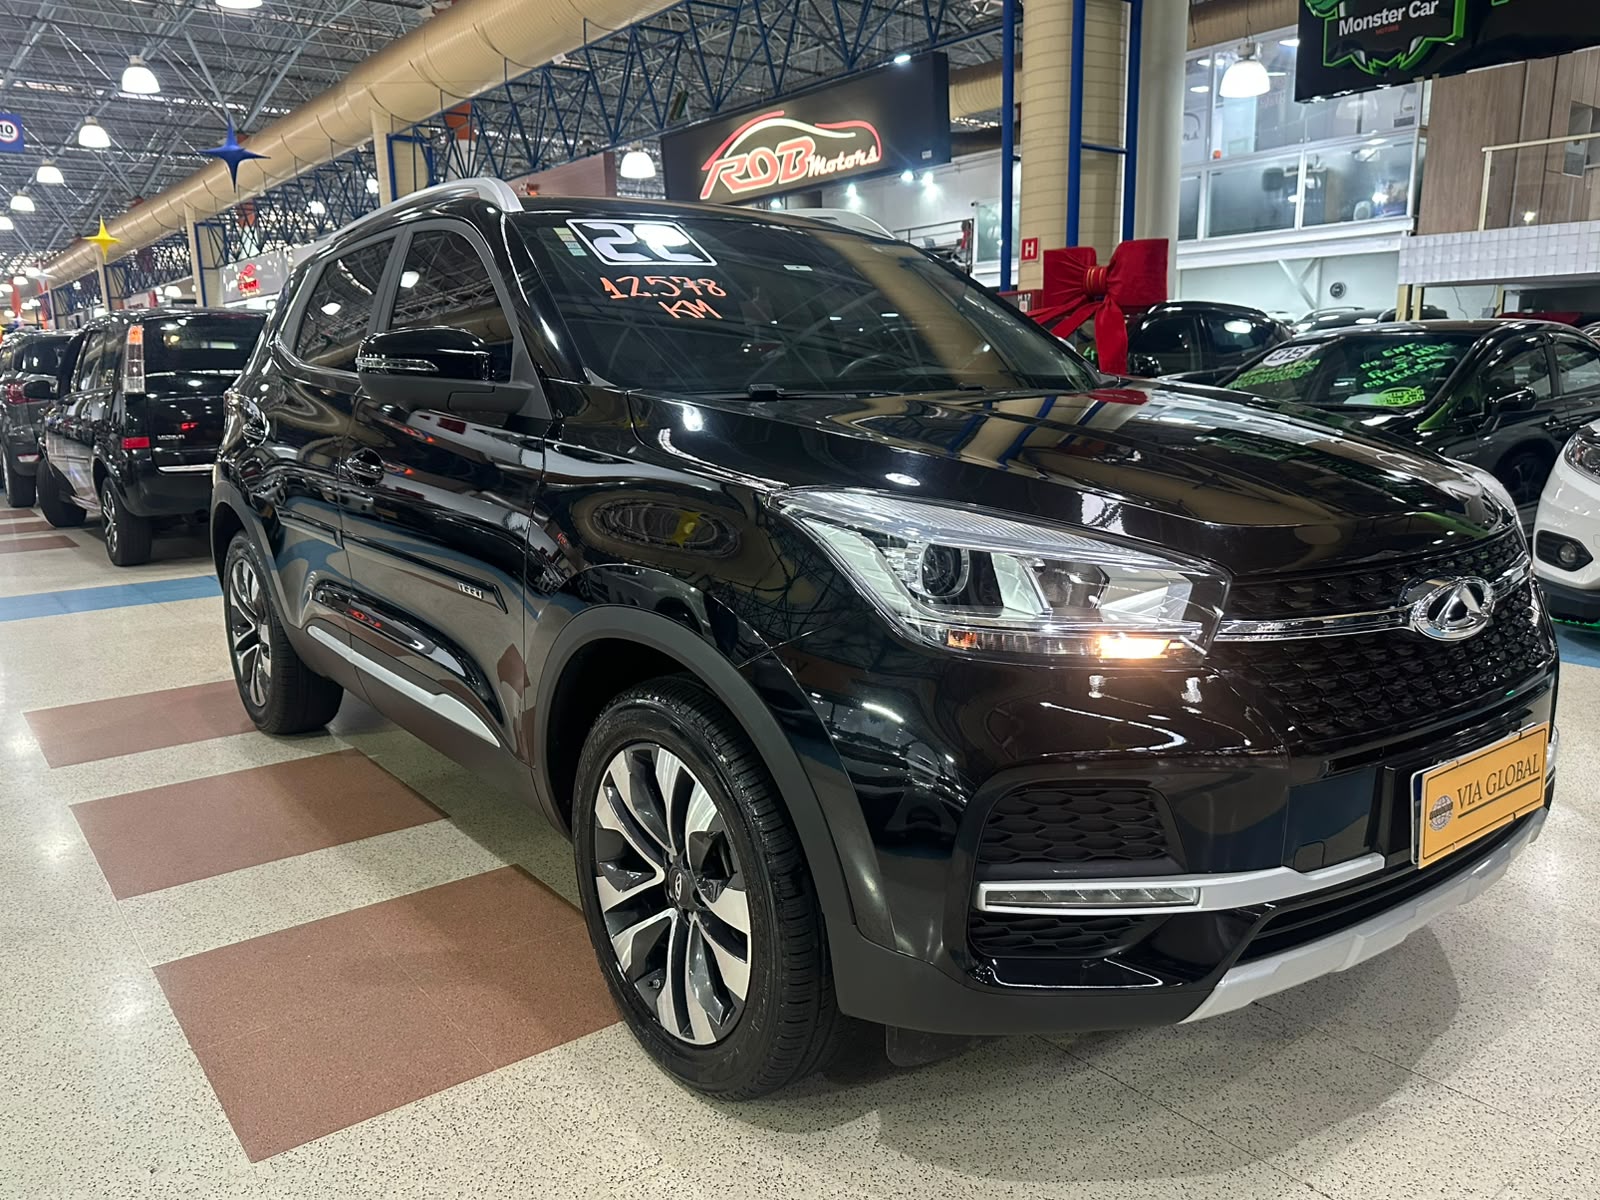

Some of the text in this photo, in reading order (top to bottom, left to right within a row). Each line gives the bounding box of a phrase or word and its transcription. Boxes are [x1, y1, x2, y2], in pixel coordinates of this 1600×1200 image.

[1338, 0, 1439, 37] Monster Car
[700, 136, 881, 200] ROB Motors
[582, 222, 704, 262] 22
[1024, 241, 1035, 257] H
[600, 275, 727, 299] 12.578
[657, 298, 723, 319] KM
[1457, 753, 1540, 809] VIA GLOBAL
